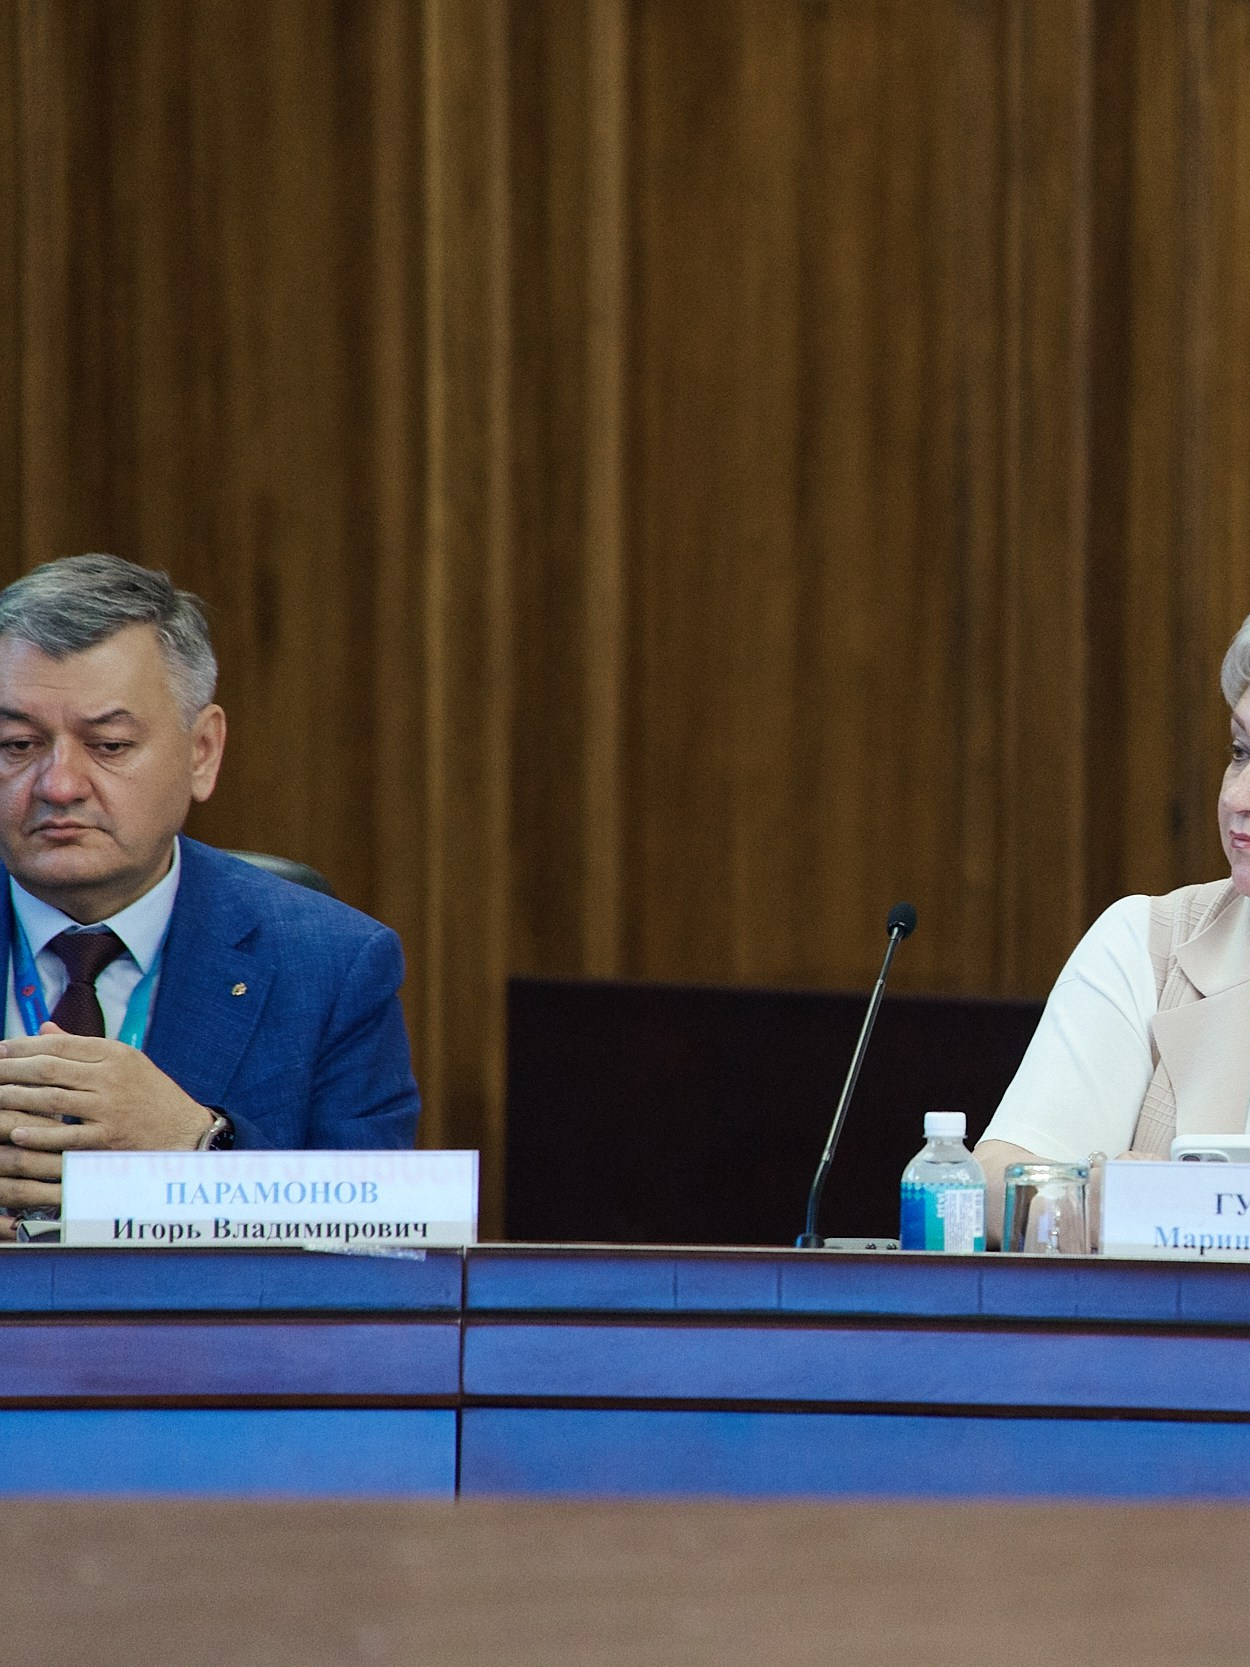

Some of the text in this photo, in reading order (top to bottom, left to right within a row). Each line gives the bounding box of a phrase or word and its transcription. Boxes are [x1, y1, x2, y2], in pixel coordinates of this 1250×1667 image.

[165, 1181, 379, 1205] ПАРАМОНОВ
[112, 1217, 429, 1244] Игорь Владимирович
